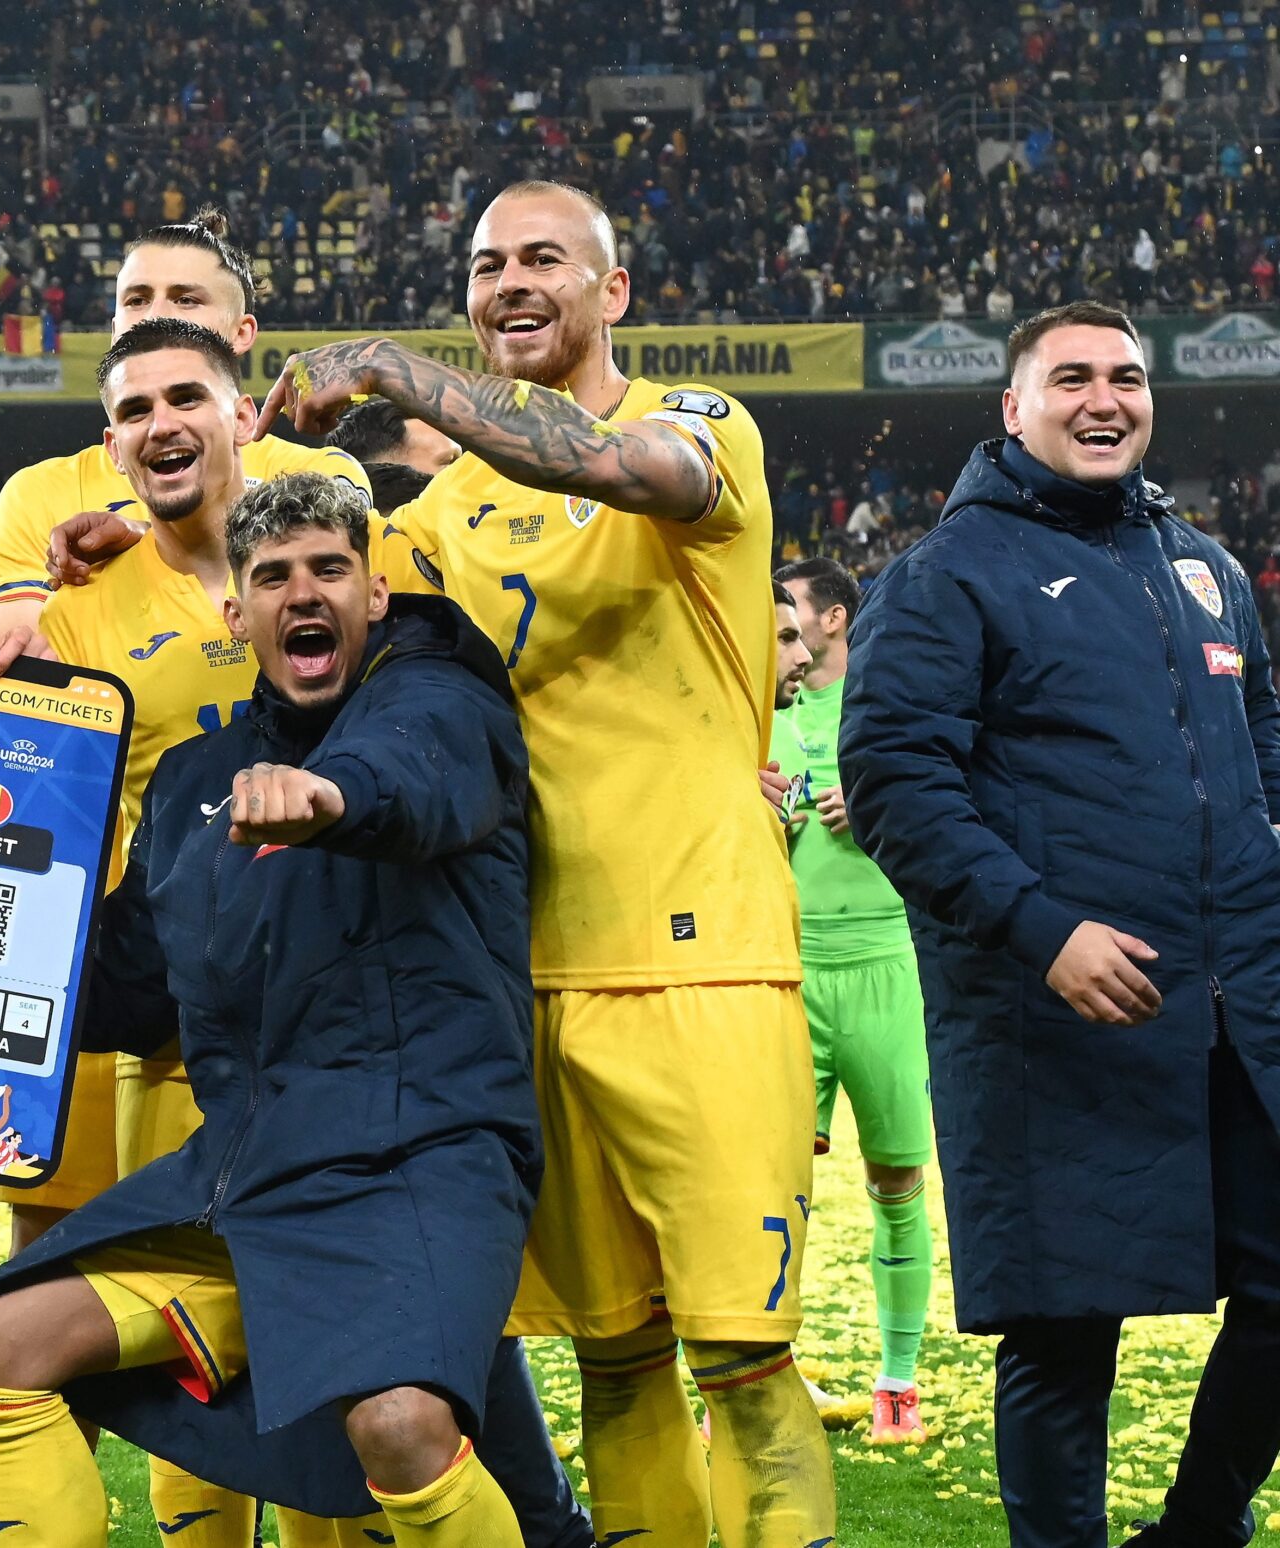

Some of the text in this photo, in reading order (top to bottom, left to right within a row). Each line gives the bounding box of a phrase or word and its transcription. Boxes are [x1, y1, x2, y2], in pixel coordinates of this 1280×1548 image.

[641, 336, 792, 375] ROMÂNIA
[888, 350, 999, 370] BUCOVINA
[509, 517, 524, 530] ROU
[528, 515, 545, 527] SUI
[500, 572, 538, 670] 7
[200, 640, 223, 653] ROU
[208, 655, 247, 668] 21.11.2023
[13, 741, 36, 753] UEFA
[3, 762, 39, 774] GERMANY
[19, 1001, 39, 1011] SEAT
[21, 1019, 30, 1030] 4
[762, 1216, 792, 1312] 7
